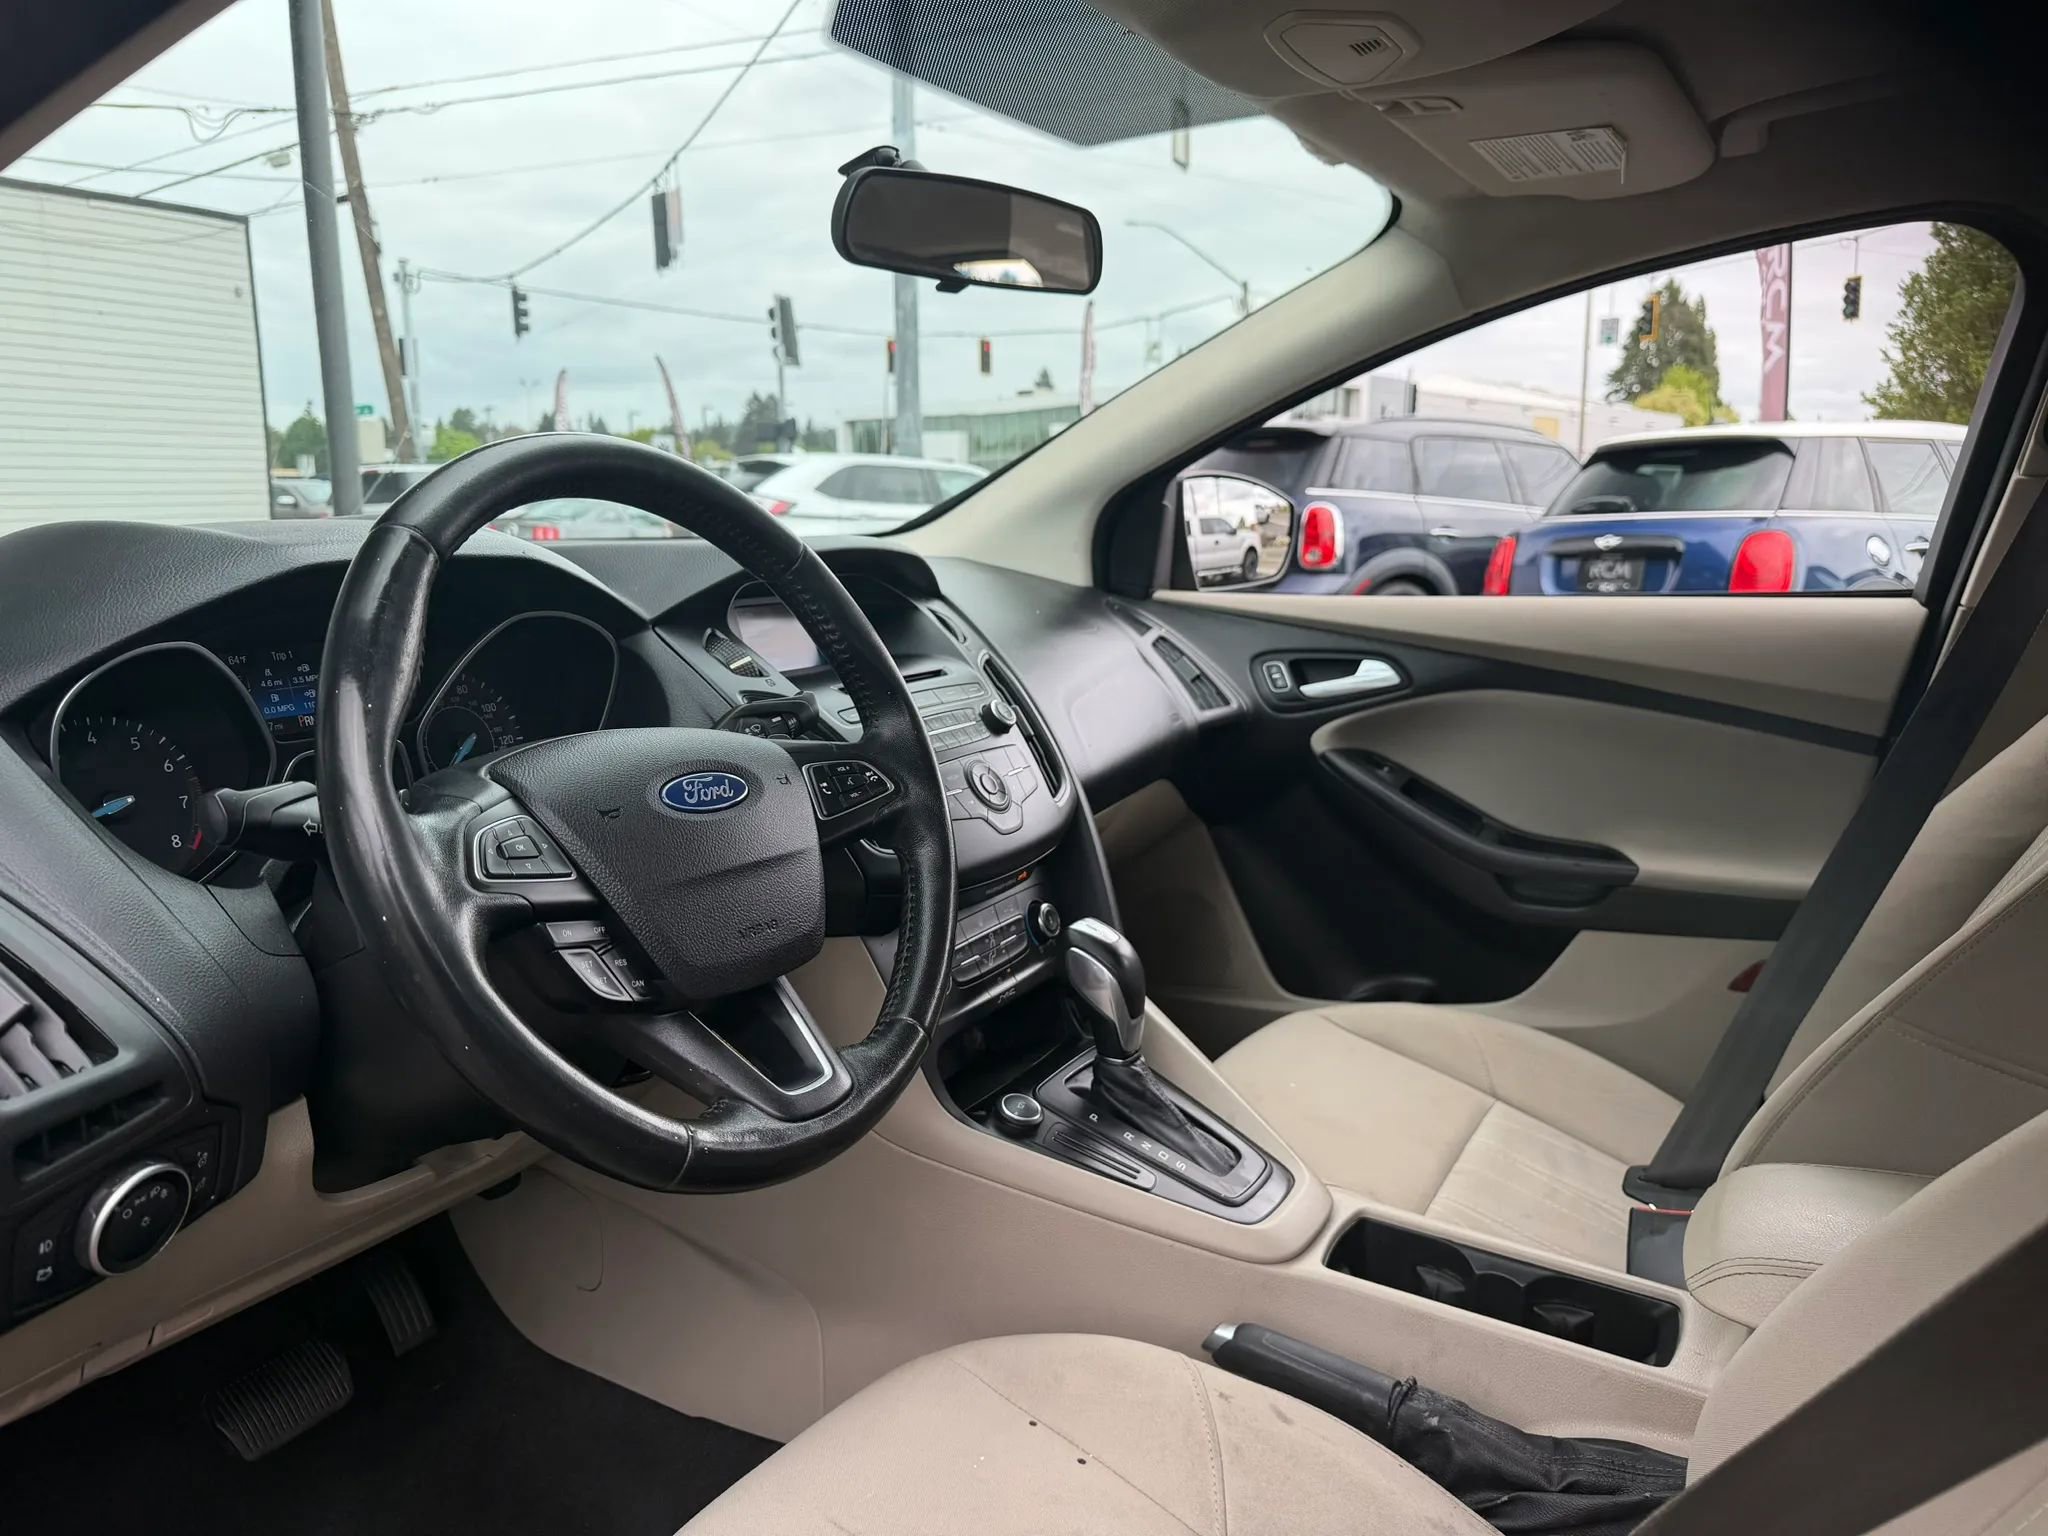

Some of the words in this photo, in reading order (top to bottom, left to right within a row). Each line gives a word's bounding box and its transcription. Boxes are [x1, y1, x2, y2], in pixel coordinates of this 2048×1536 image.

[1588, 561, 1632, 579] RCM
[271, 651, 287, 661] Trip
[277, 703, 295, 713] MPG
[481, 702, 497, 713] 100
[87, 731, 97, 744] 4
[130, 737, 141, 751] 5
[498, 735, 514, 746] 120
[163, 759, 174, 773] 6
[682, 776, 734, 804] Ford
[178, 795, 189, 809] 7
[171, 834, 182, 848] 8
[562, 928, 572, 937] ON
[593, 926, 605, 934] OFF
[614, 959, 628, 967] RES
[631, 980, 645, 988] CAN
[1089, 1113, 1099, 1123] P
[1123, 1131, 1135, 1142] R
[1141, 1141, 1153, 1151] N
[1158, 1150, 1169, 1161] D
[1175, 1160, 1187, 1172] S
